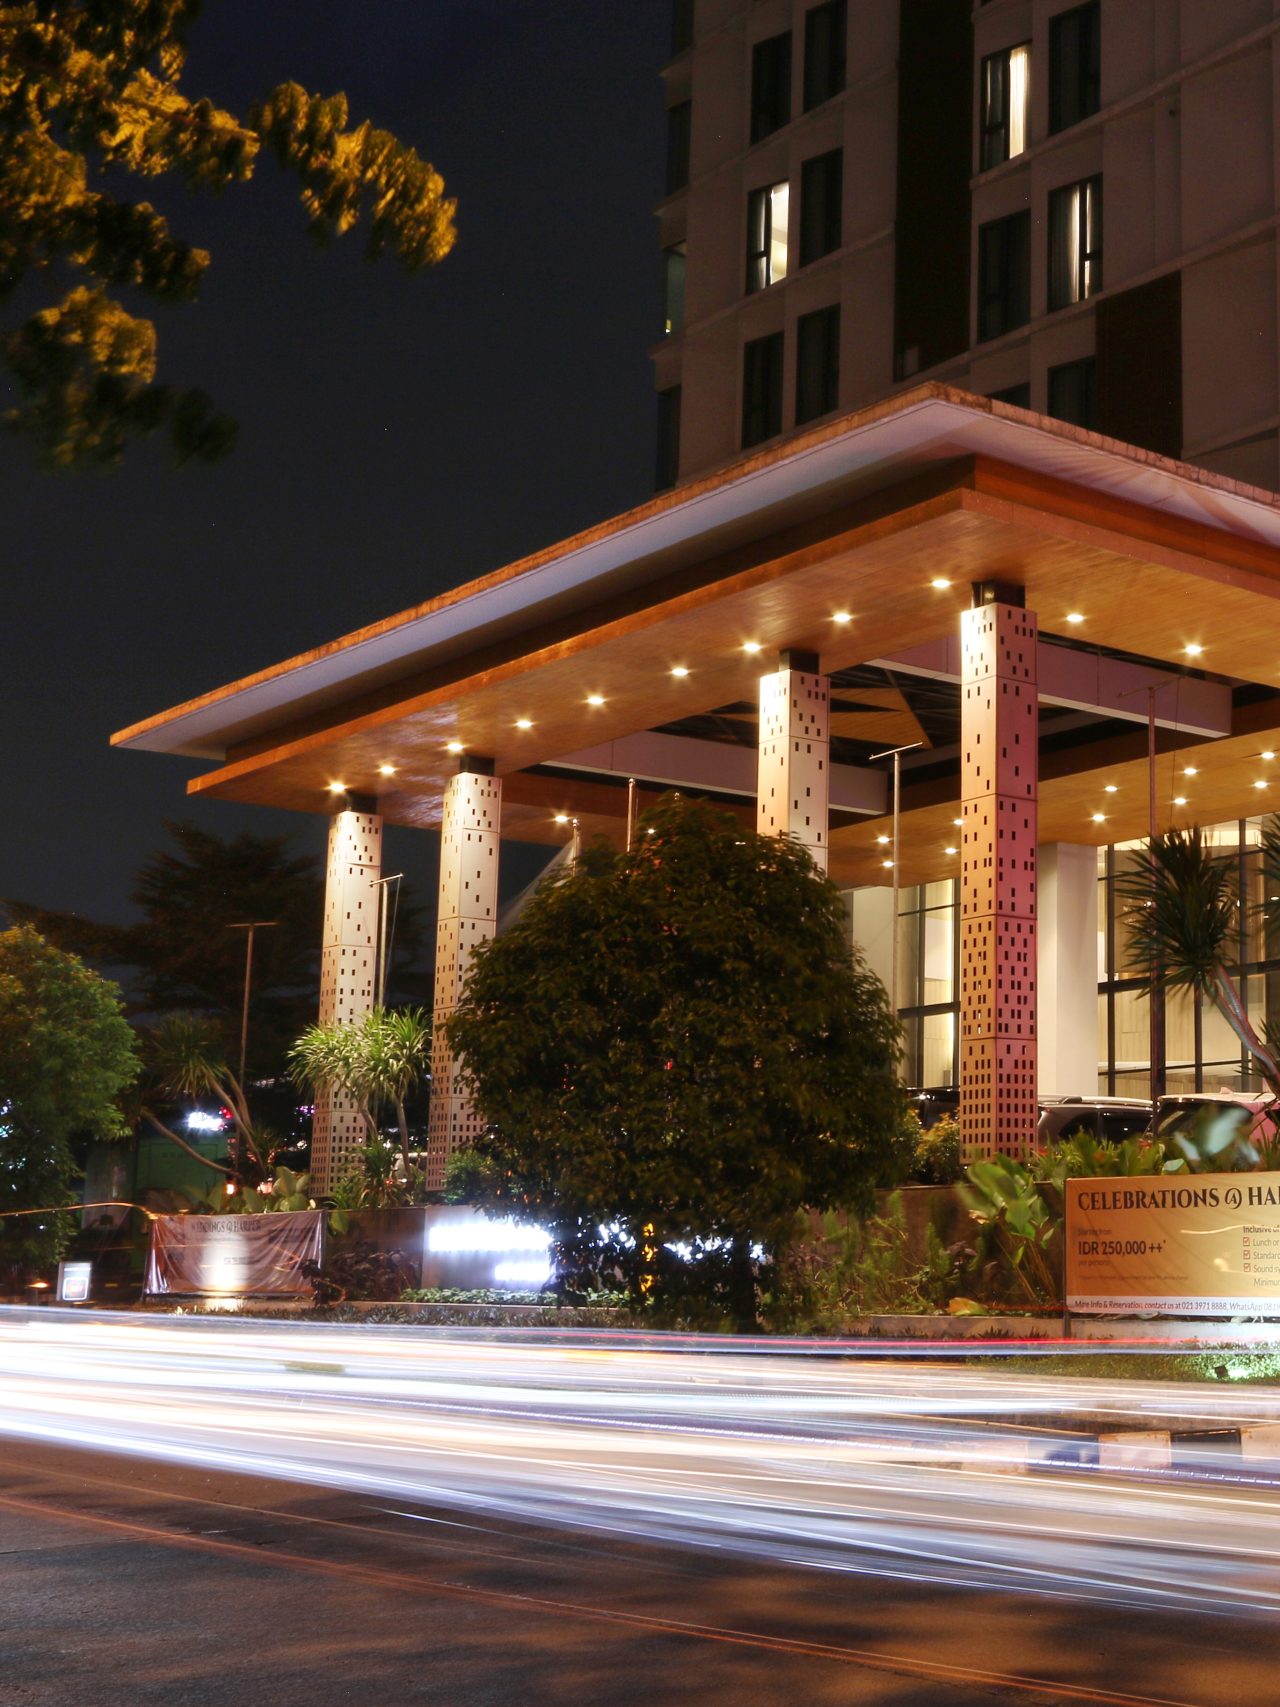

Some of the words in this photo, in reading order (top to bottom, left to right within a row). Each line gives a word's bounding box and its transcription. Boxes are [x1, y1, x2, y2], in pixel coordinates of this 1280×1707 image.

[1077, 1188, 1220, 1211] CELEBRATIONS
[1243, 1225, 1272, 1234] Inclusive
[1252, 1238, 1272, 1247] Lunch
[1078, 1241, 1099, 1256] IDR
[1101, 1240, 1147, 1257] 250,000
[1253, 1250, 1280, 1260] Standard
[1253, 1264, 1273, 1273] Sound
[1090, 1300, 1102, 1309] Info
[1144, 1301, 1166, 1310] contact
[1181, 1301, 1193, 1310] 021
[1194, 1301, 1210, 1310] 3971
[1229, 1302, 1263, 1312] WhatsApp
